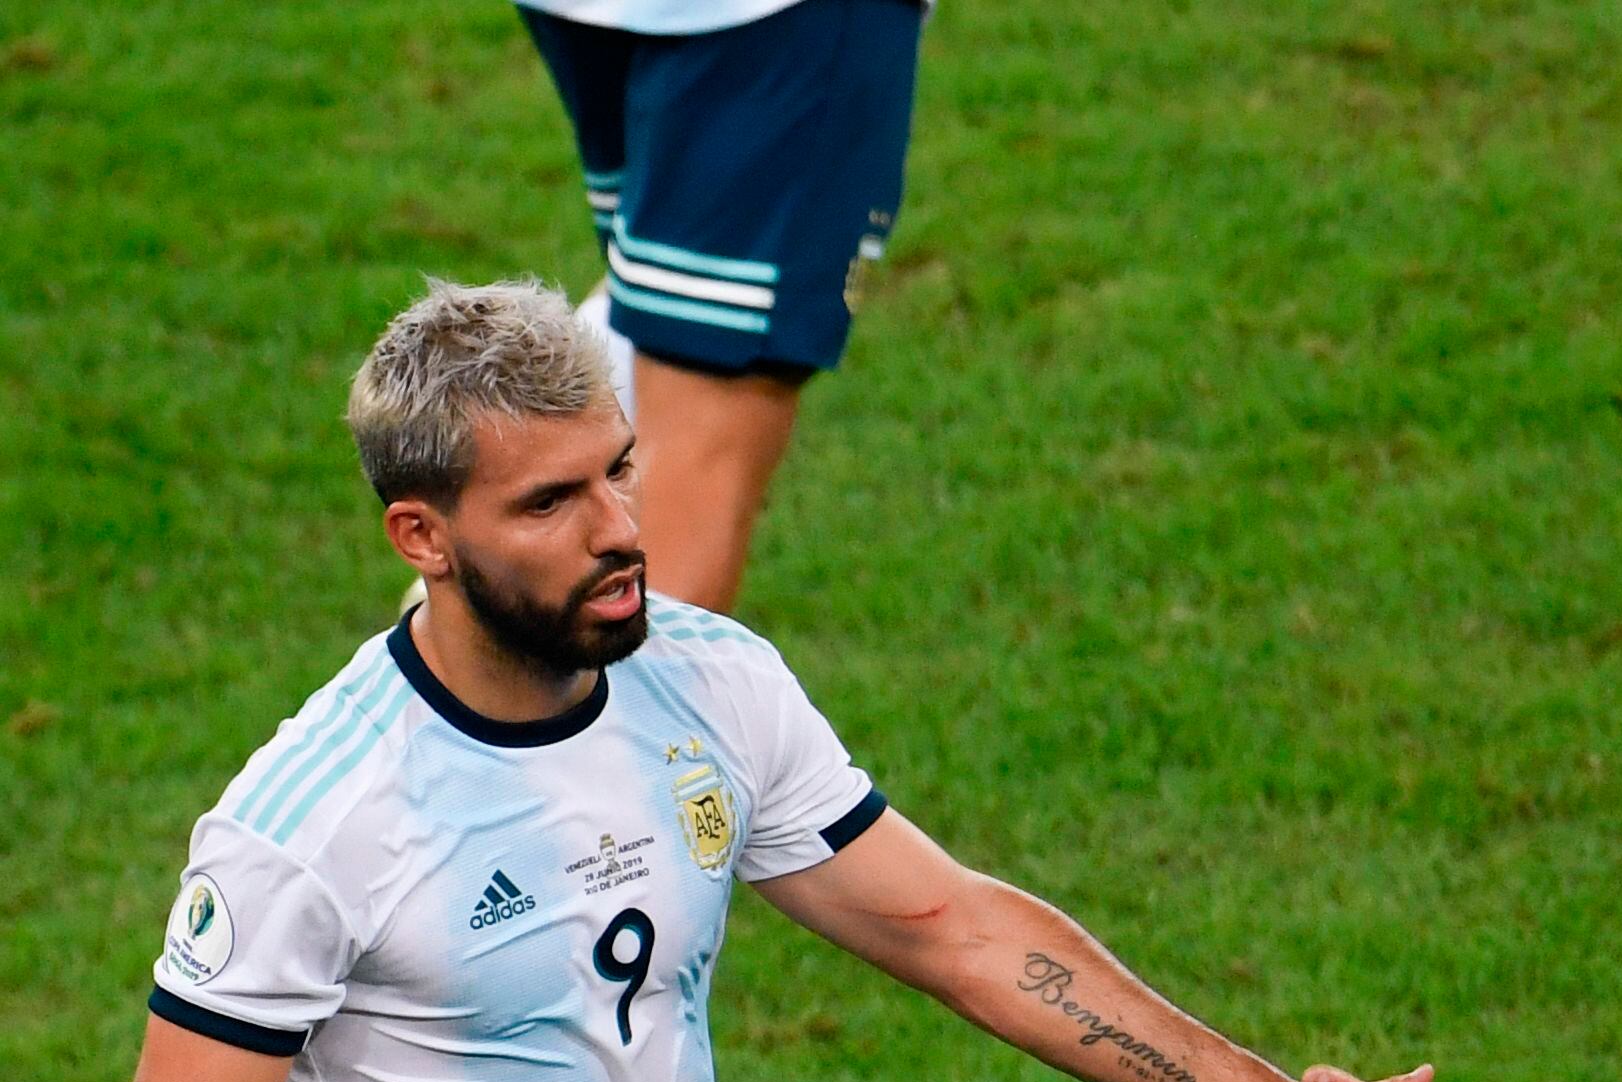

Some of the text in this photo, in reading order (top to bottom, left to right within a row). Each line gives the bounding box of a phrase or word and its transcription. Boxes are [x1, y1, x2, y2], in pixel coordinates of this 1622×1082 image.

[690, 795, 726, 840] AFA
[618, 836, 655, 854] ARGENTINA
[584, 872, 594, 883] 28
[622, 855, 643, 870] 2019
[599, 881, 611, 891] DE
[614, 867, 650, 887] JANEIRO
[470, 895, 536, 930] adidas
[593, 907, 656, 1046] 9
